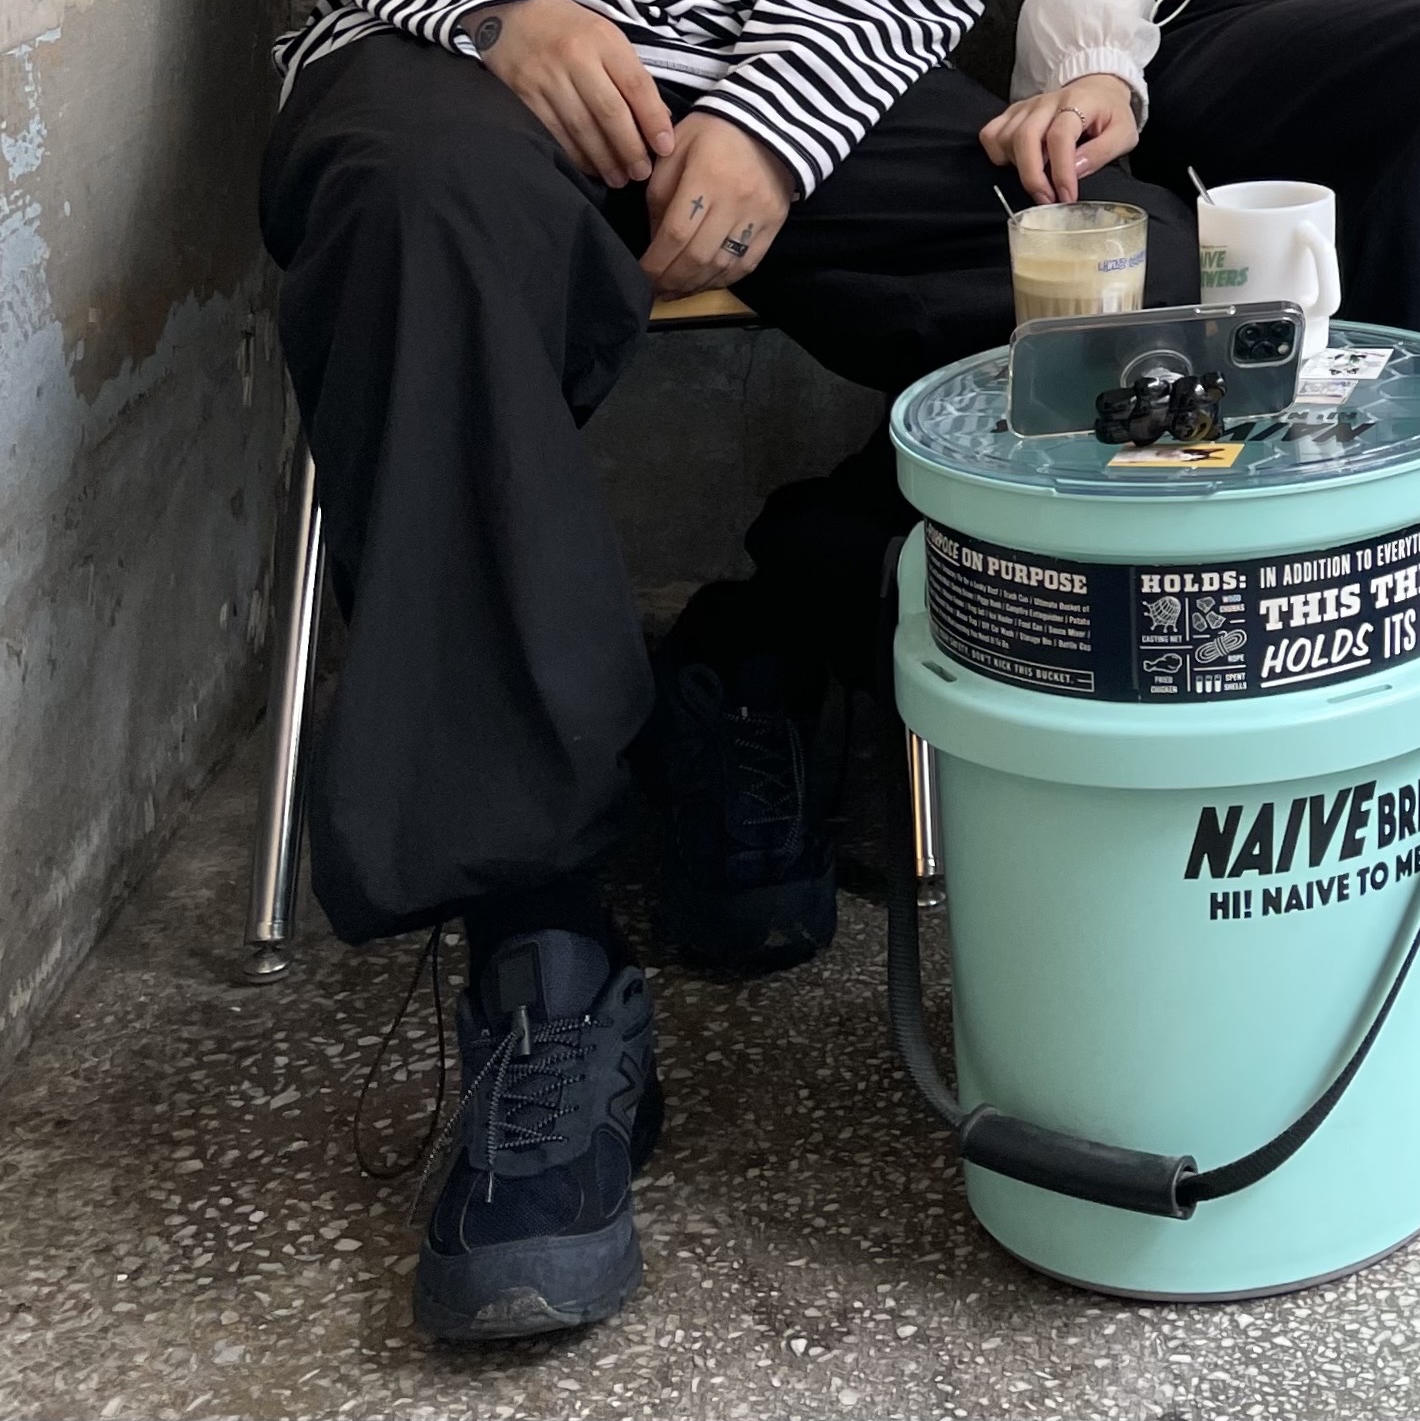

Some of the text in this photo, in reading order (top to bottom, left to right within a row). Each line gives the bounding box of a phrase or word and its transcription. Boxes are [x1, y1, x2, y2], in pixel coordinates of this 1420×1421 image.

[961, 547, 983, 572] ON
[987, 556, 1088, 595] PURPOSE
[1141, 570, 1246, 593] HOLDS:
[1260, 566, 1276, 588] IN
[1283, 553, 1351, 586] ADDITION
[1356, 549, 1373, 572] TO
[1260, 583, 1361, 631] THIS
[1261, 622, 1374, 678] HOLDS
[1384, 609, 1416, 658] ITS
[1014, 663, 1033, 677] THIS
[1184, 780, 1377, 880] NAIVE
[1210, 889, 1252, 920] HI!
[1263, 873, 1350, 916] NAIVE
[1356, 861, 1389, 896] TO
